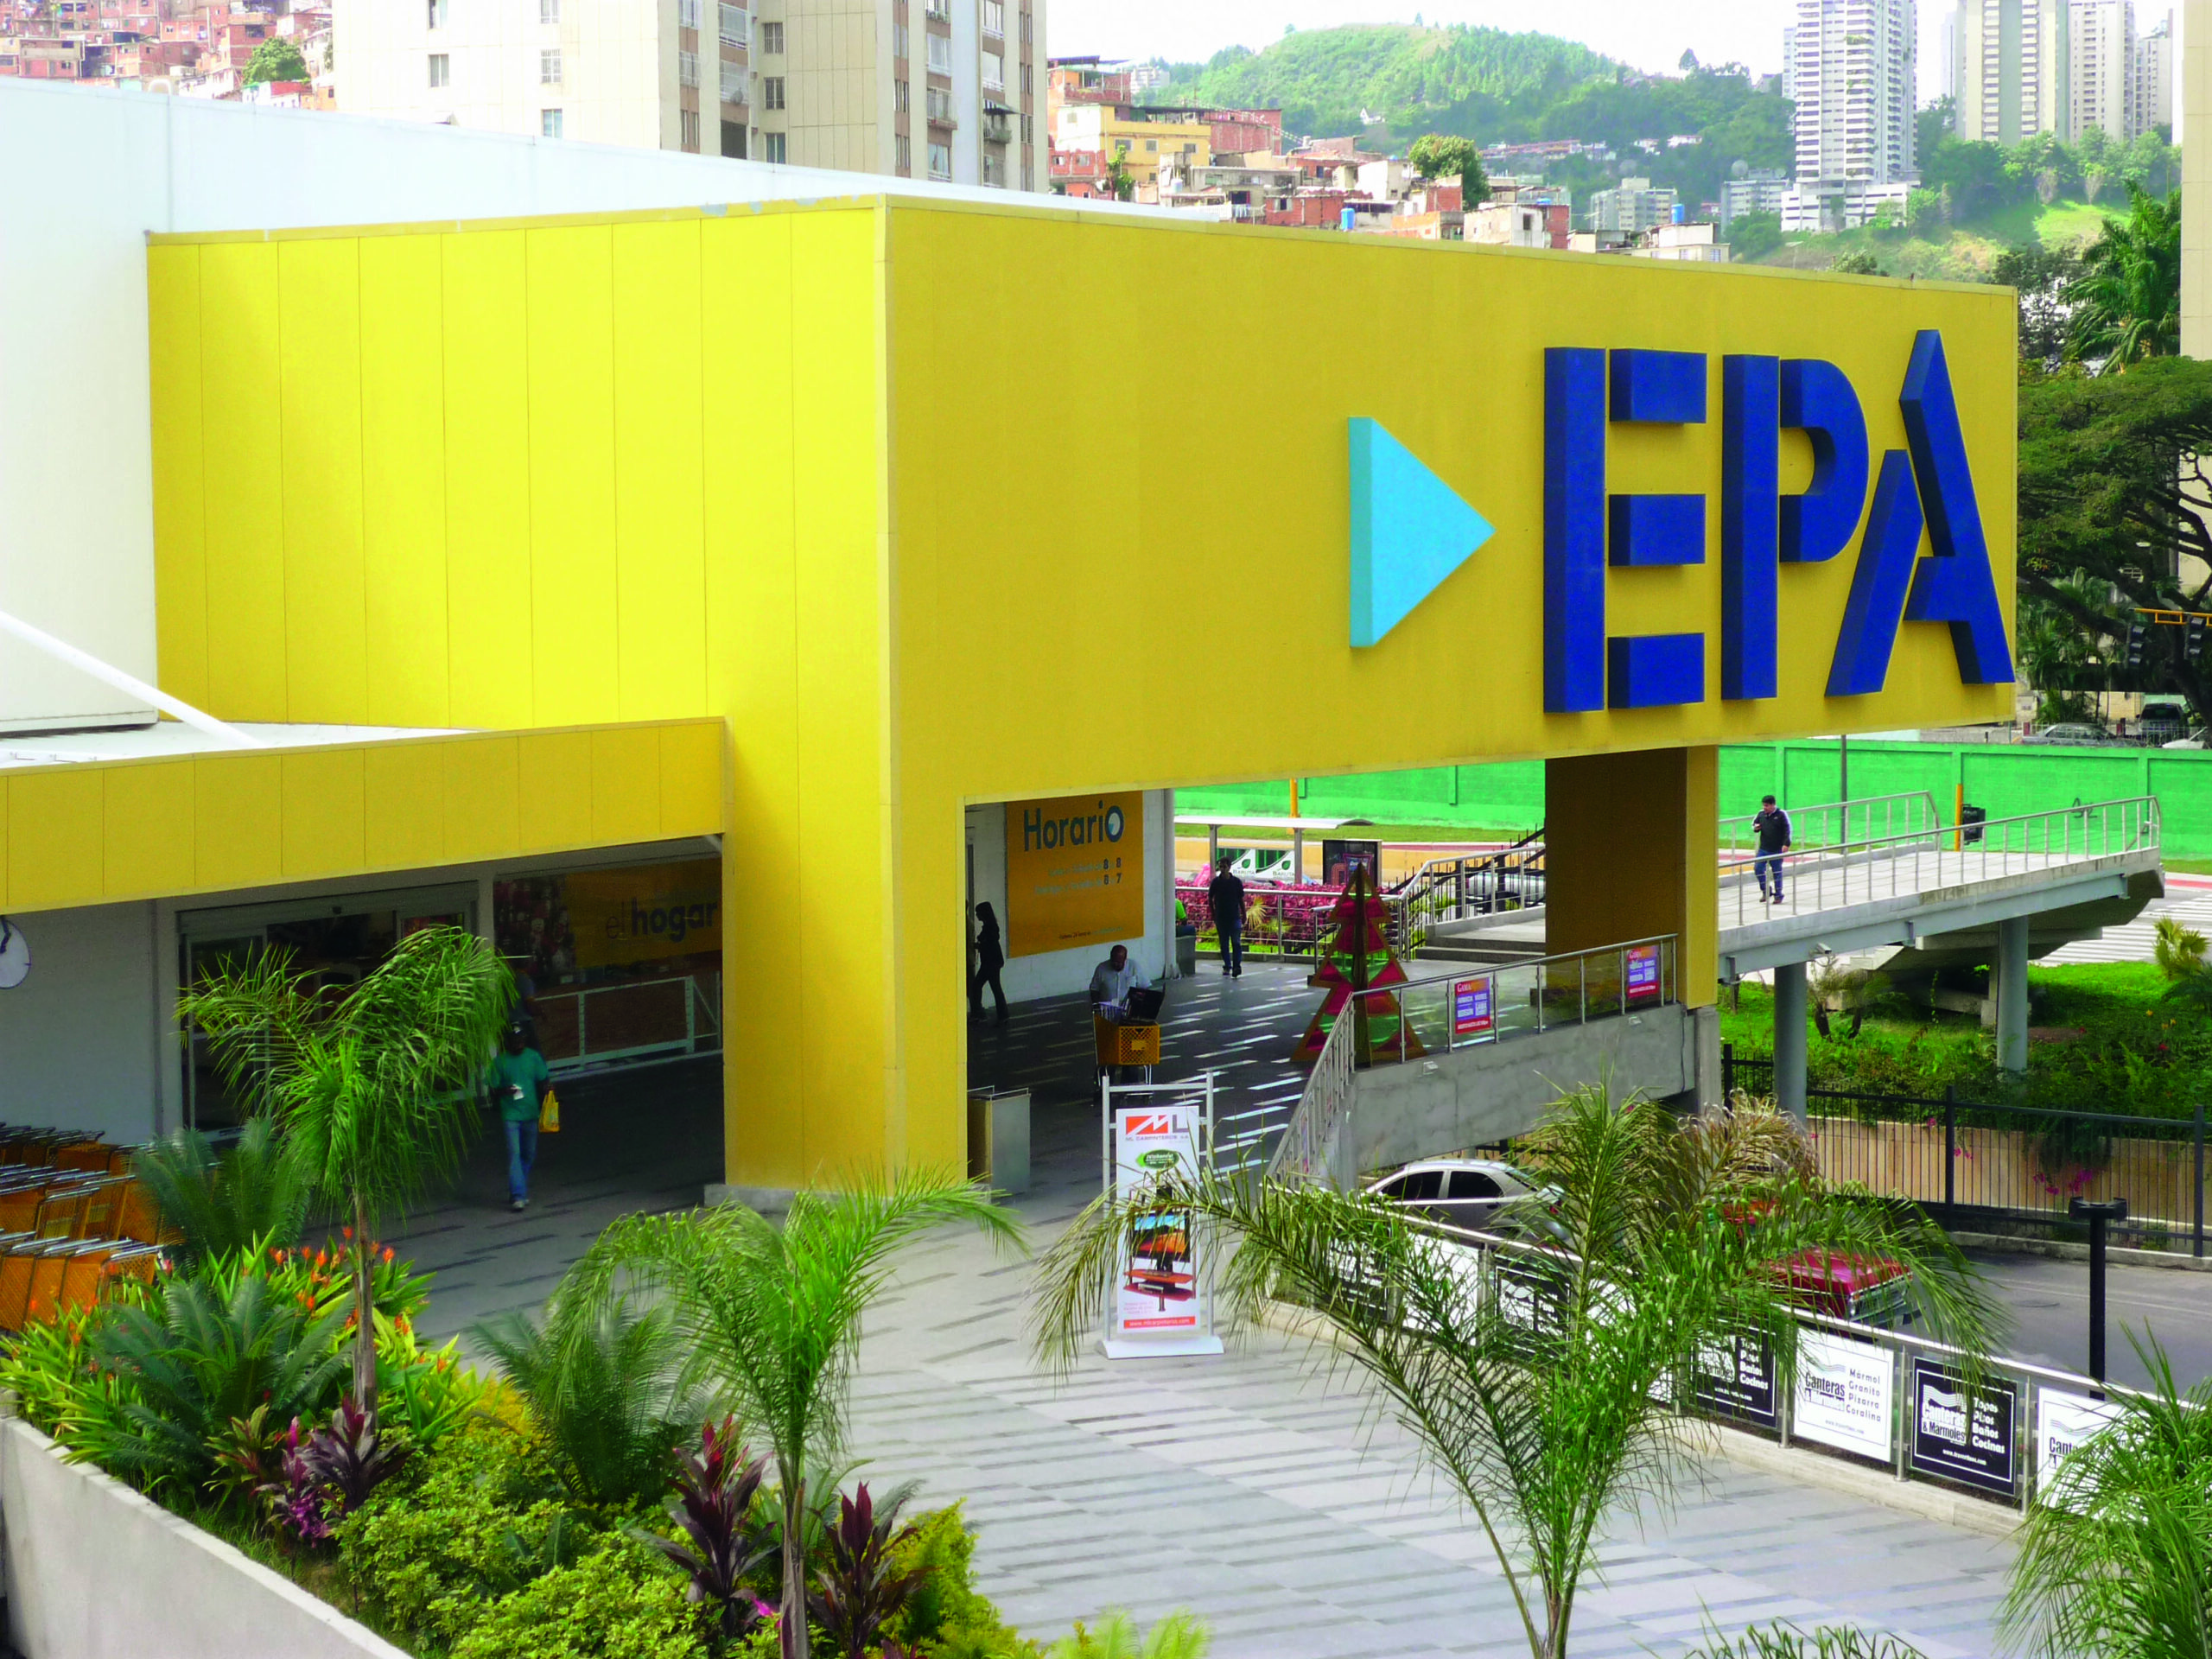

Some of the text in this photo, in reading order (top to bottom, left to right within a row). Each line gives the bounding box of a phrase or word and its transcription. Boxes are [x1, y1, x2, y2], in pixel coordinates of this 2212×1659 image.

[1543, 329, 2016, 713] EPA
[1024, 801, 1124, 852] Horario
[1116, 873, 1122, 884] 7
[607, 897, 718, 942] el hogar
[1739, 1372, 1769, 1390] Cocinas
[1805, 1371, 1845, 1397] Canteras
[1849, 1368, 1880, 1384] Mármol
[1849, 1381, 1880, 1396] Granito
[1848, 1392, 1879, 1409] Pizarra
[1846, 1404, 1881, 1422] Coralina
[1922, 1401, 1966, 1427] Canteras
[1972, 1421, 1999, 1439] Baños
[1972, 1435, 2005, 1453] Cocinas
